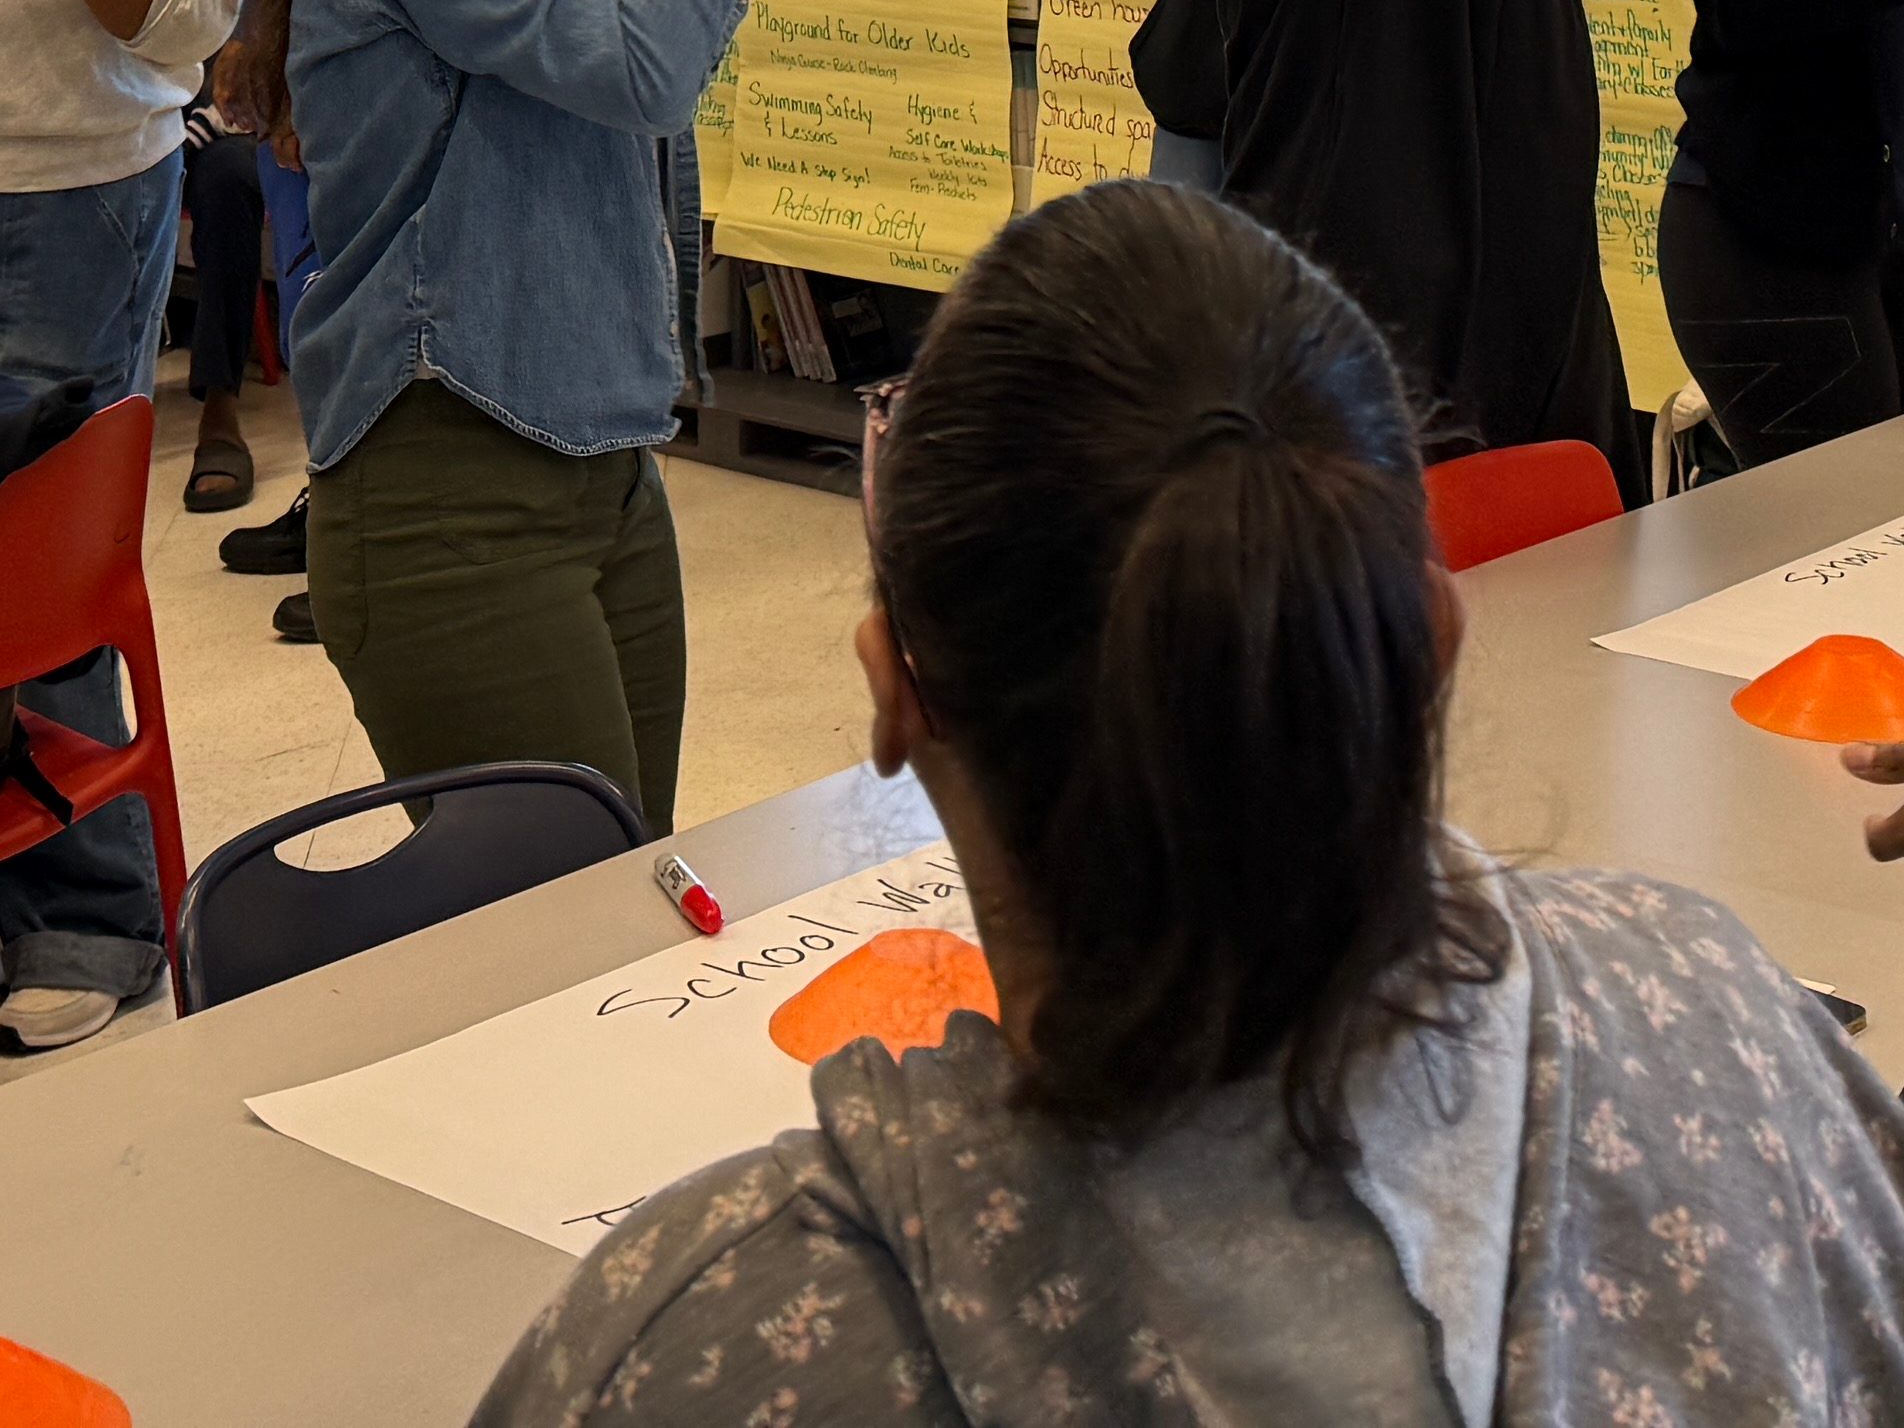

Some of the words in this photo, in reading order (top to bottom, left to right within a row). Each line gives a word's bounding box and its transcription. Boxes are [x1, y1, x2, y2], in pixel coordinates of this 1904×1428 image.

[756, 0, 832, 44] Playground
[838, 17, 859, 44] for
[866, 19, 915, 51] Older
[925, 27, 971, 59] Kids
[748, 80, 823, 127] Swimming
[825, 93, 874, 135] Safety
[906, 94, 960, 126] Hygiene
[781, 117, 838, 146] Lessons
[905, 128, 931, 147] Self
[934, 133, 957, 152] Care
[740, 151, 762, 169] We
[767, 156, 797, 175] Need
[800, 160, 809, 175] A
[1036, 136, 1083, 182] Access
[771, 185, 863, 232] Pedestrian
[866, 203, 927, 252] Safety
[889, 251, 928, 272] Dental
[1784, 546, 1889, 585] School
[595, 913, 859, 1019] School
